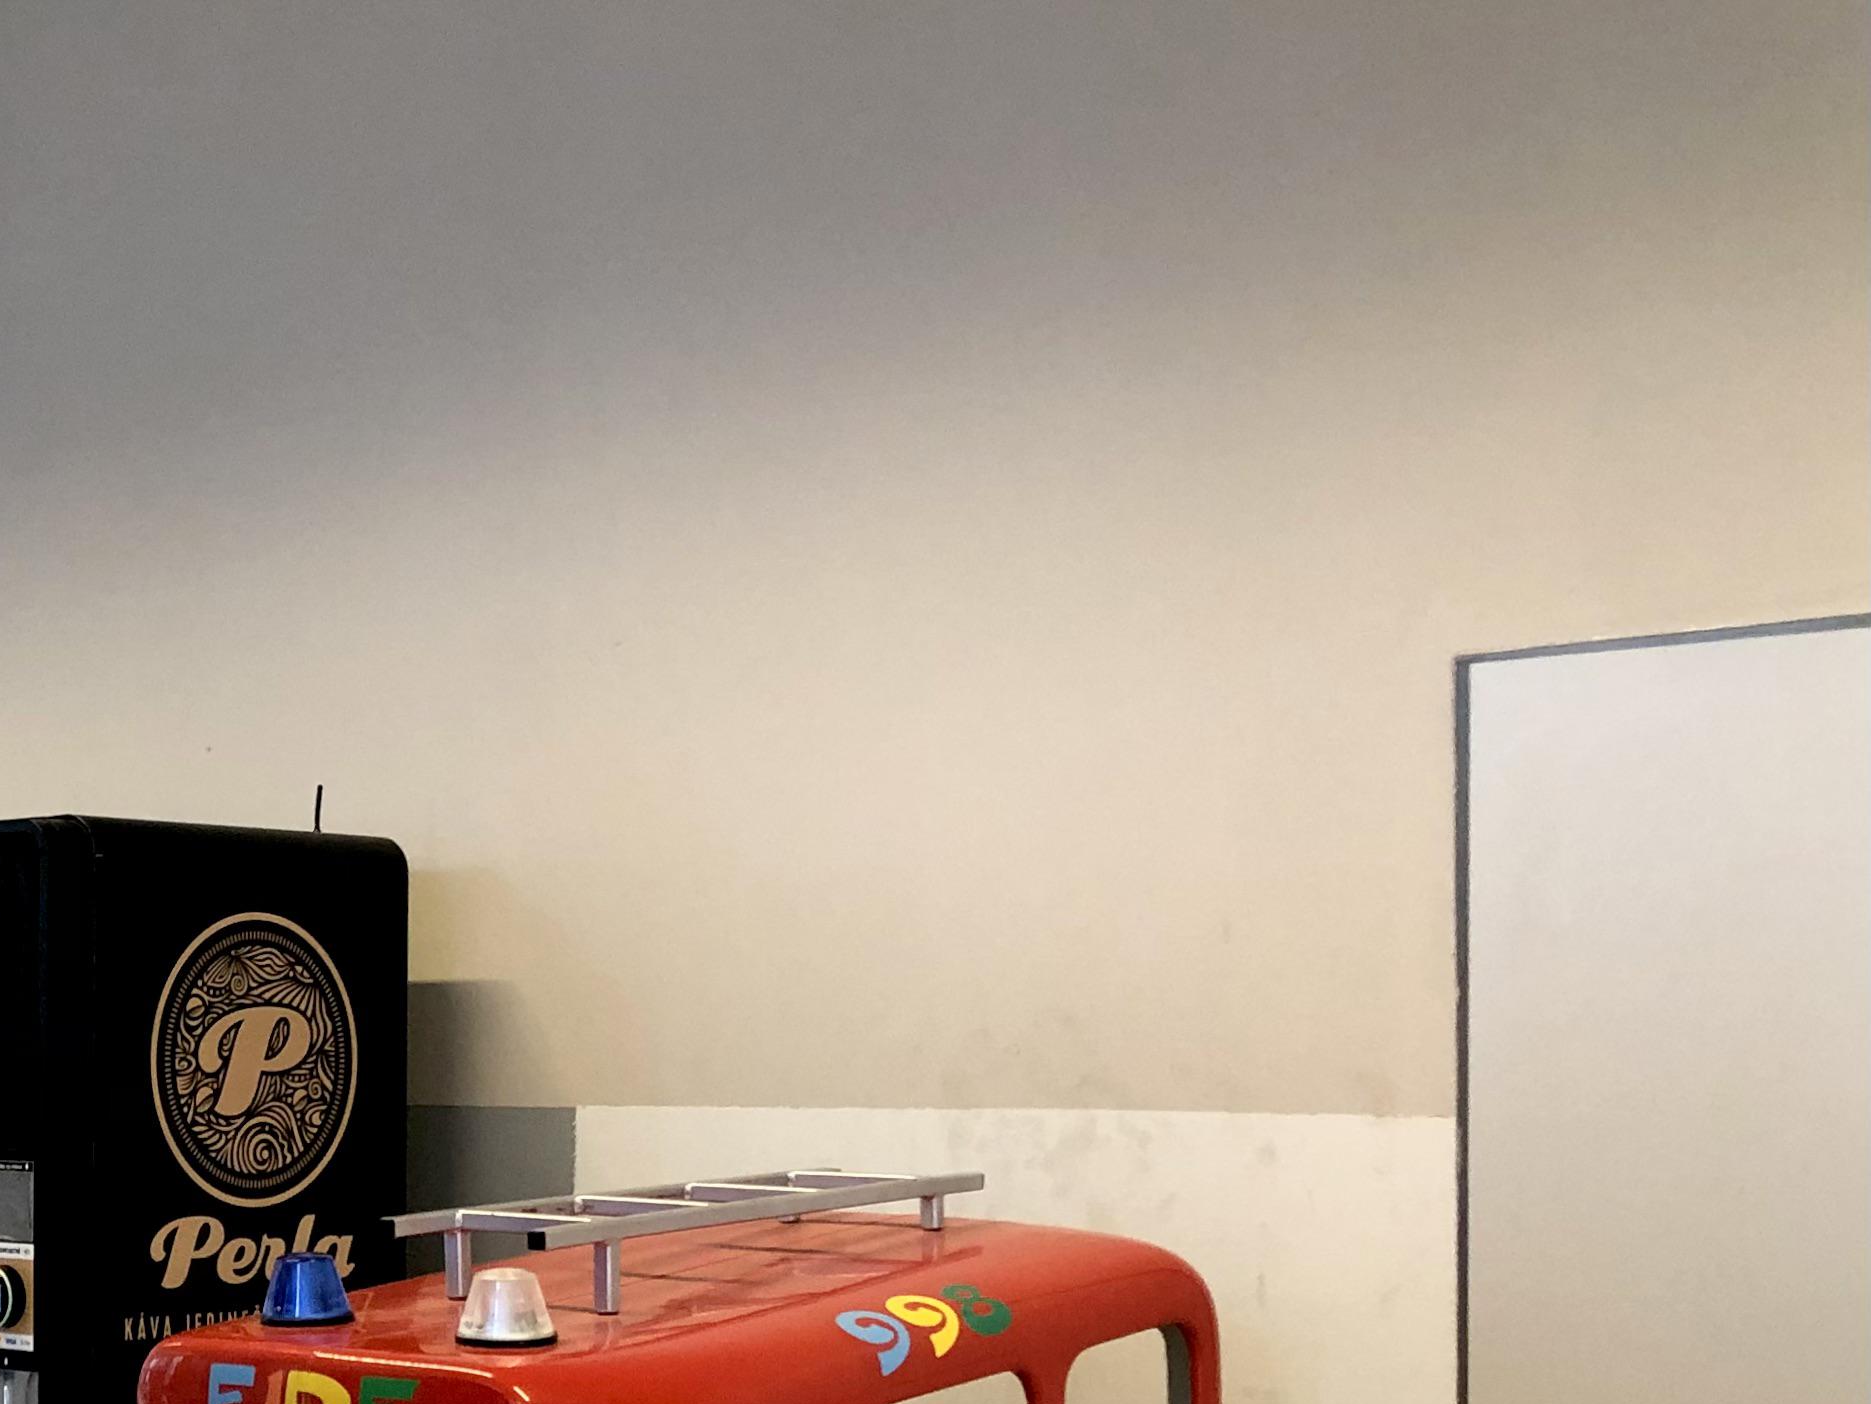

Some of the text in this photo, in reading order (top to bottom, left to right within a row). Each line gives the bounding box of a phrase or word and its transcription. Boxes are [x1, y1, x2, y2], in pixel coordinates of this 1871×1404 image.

[198, 1006, 312, 1117] P
[149, 1214, 355, 1289] Perla
[124, 1311, 172, 1341] KÁVA
[835, 1284, 1013, 1377] 998
